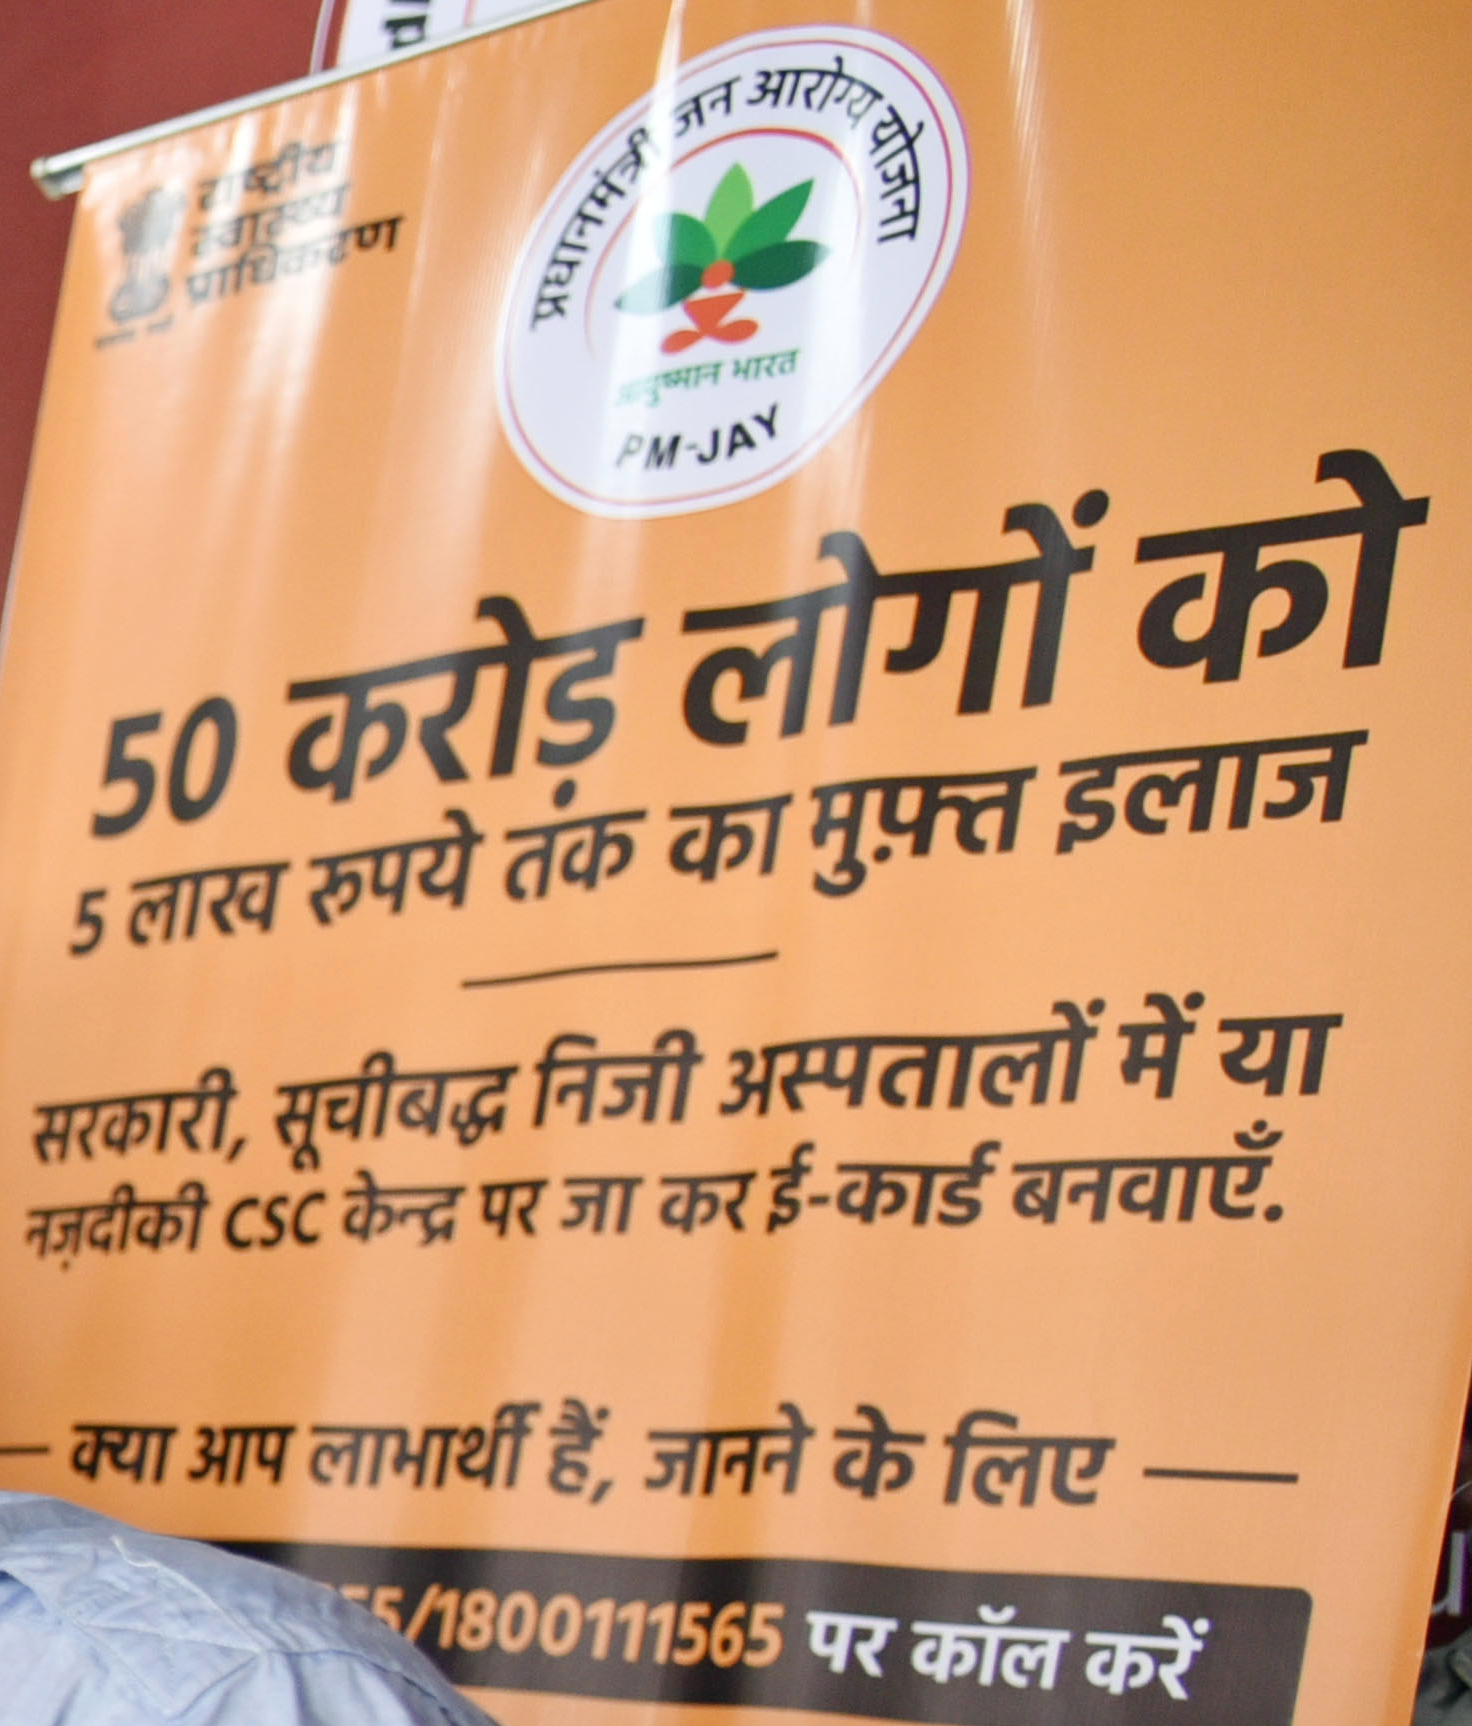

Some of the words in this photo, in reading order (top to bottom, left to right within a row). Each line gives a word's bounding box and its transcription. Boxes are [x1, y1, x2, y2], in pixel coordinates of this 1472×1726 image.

[672, 75, 742, 140] जन
[746, 56, 884, 131] आरोग्य
[869, 103, 925, 245] योजना
[615, 402, 780, 472] PM-JAY
[730, 346, 801, 382] भारत
[90, 695, 239, 839] 50
[286, 594, 646, 809] करोड़
[681, 488, 1111, 748] लोगों
[1135, 447, 1432, 685] को
[70, 888, 108, 957] 5
[128, 861, 291, 946] लाख
[505, 808, 649, 902] तक
[669, 792, 796, 881] का
[811, 766, 1039, 898] मुफ़्त
[1056, 728, 1372, 855] इलाज
[33, 1066, 251, 1166] सरकारी,
[274, 1050, 521, 1172] सूचीबद्ध
[533, 1028, 705, 1128] निजी
[719, 999, 1108, 1116] अस्पतालों
[1117, 991, 1207, 1100] में
[1218, 1012, 1346, 1098] या
[25, 1179, 211, 1273] नज़दीकी
[223, 1190, 328, 1250] CSC
[343, 1168, 468, 1248] केन्द्र
[480, 1178, 550, 1238] पर
[560, 1176, 644, 1234] जा
[659, 1170, 758, 1234] कर
[766, 1139, 1002, 1234] ई-कार्ड
[1012, 1117, 1286, 1225] बनवाएँ.
[70, 1422, 179, 1485] क्या
[187, 1424, 298, 1485] आप
[309, 1401, 542, 1490] लाभार्थी
[548, 1397, 612, 1504] हैं,
[645, 1401, 816, 1496] जानने
[833, 1403, 927, 1500] के
[943, 1409, 1118, 1507] लिए
[321, 1582, 786, 1669] 5/1800111565
[805, 1609, 899, 1678] पर
[909, 1604, 1073, 1691] कॉल
[1084, 1614, 1213, 1701] करें
